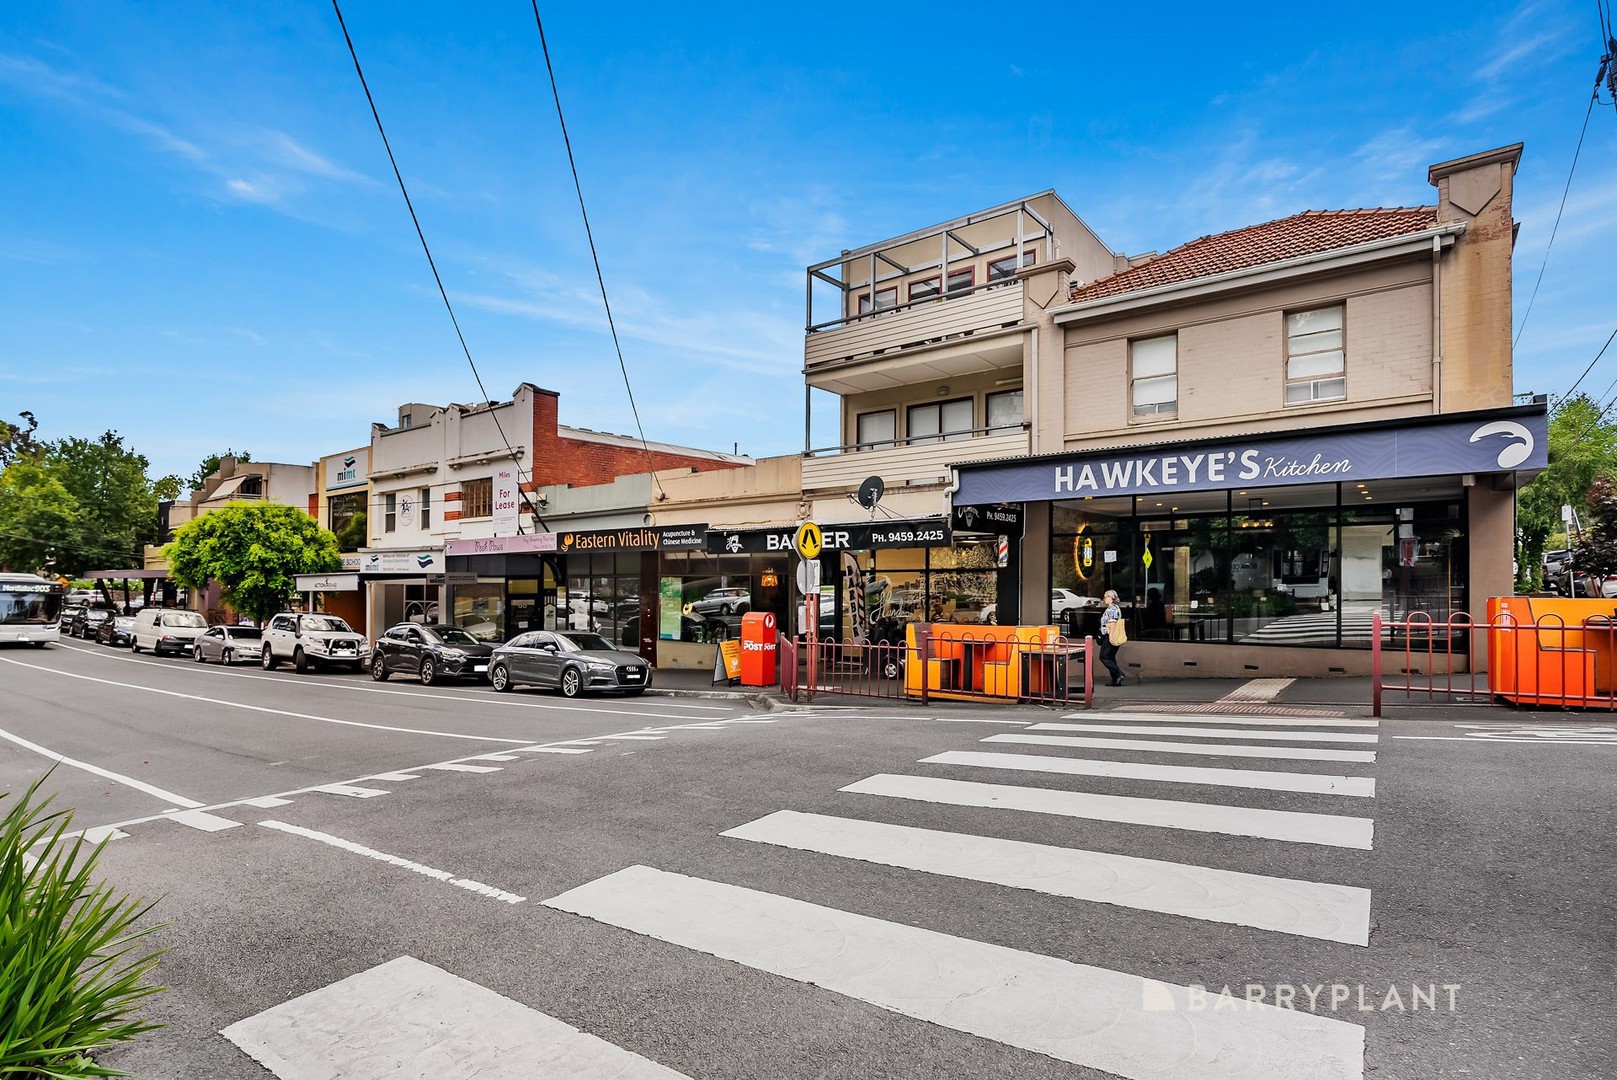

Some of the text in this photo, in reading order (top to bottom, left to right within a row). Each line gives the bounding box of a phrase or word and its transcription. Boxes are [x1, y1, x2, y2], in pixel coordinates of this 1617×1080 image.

[1055, 449, 1352, 493] HAWKEYE'S Kitchen
[499, 489, 511, 498] For
[495, 501, 515, 510] Lease
[662, 530, 691, 538] Acupuncture
[888, 530, 944, 543] 9459.2425
[575, 534, 616, 549] Eastern
[618, 529, 660, 550] Vitality
[662, 537, 702, 546] Chinese Medicine
[766, 531, 851, 550] BAER
[34, 584, 51, 593] 903
[743, 643, 763, 651] POST
